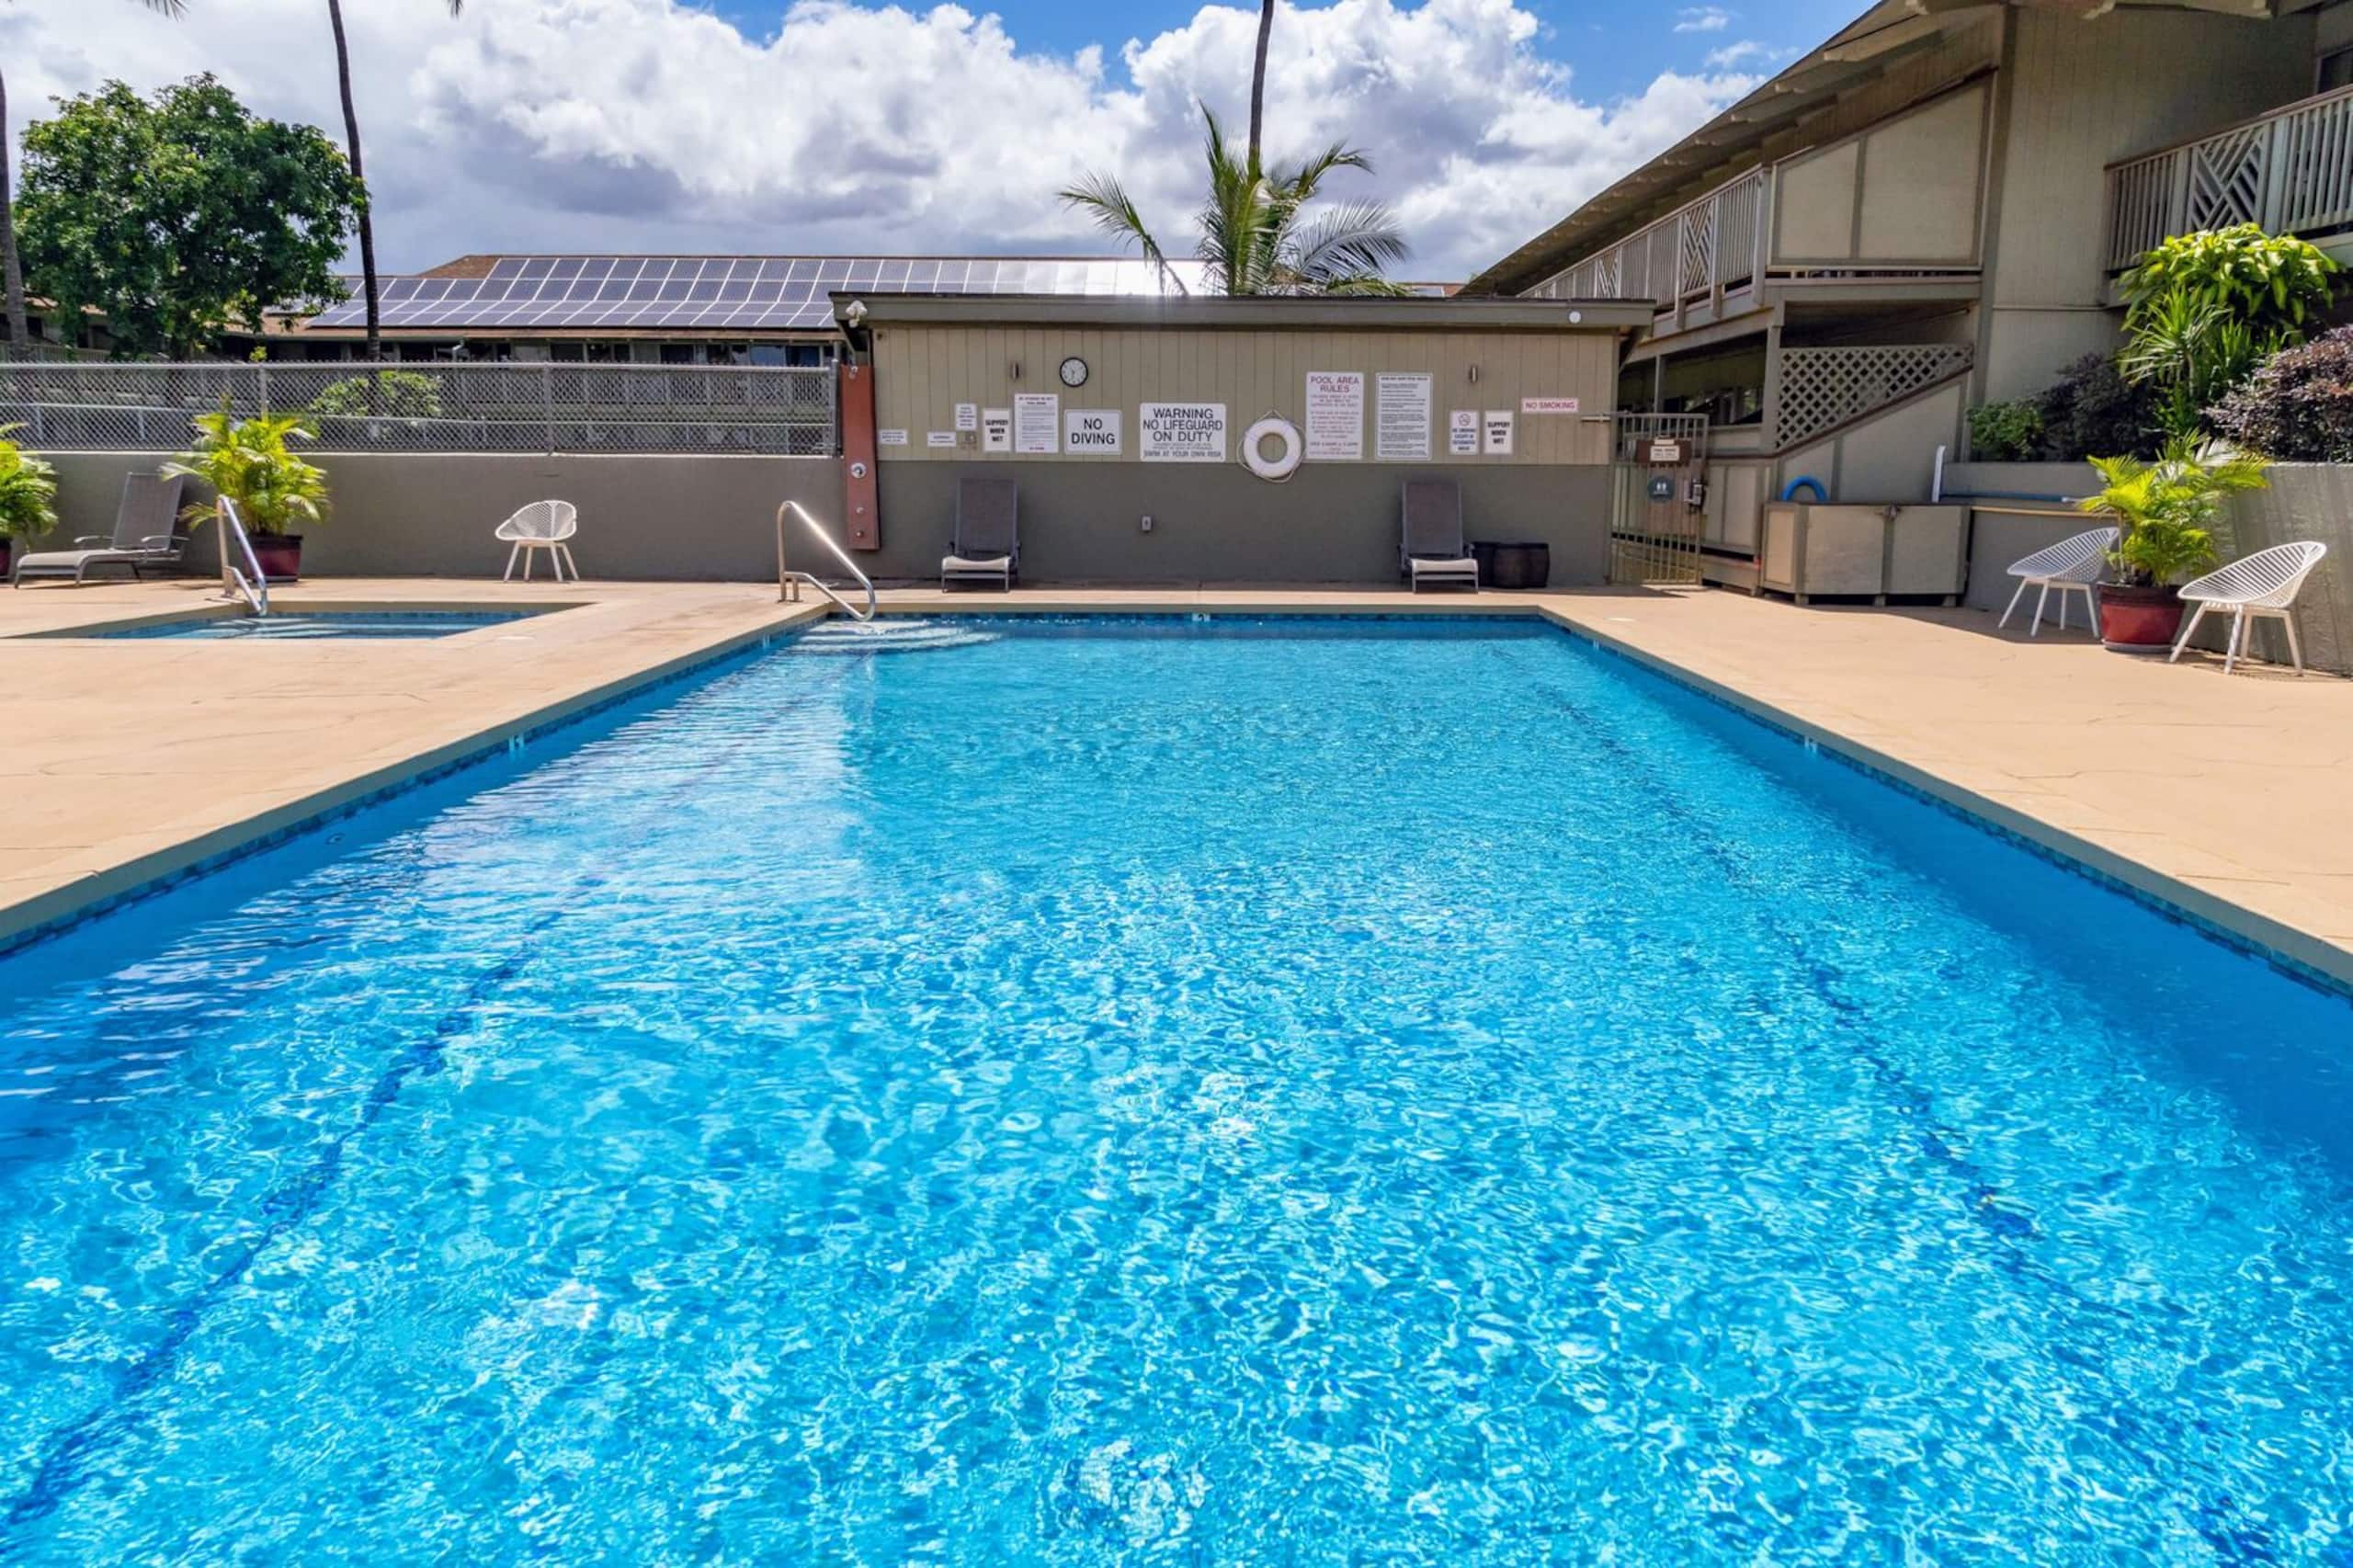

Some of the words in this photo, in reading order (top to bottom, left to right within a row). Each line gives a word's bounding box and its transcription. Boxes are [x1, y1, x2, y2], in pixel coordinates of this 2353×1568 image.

[1311, 376, 1333, 384] POOL
[1336, 376, 1359, 384] AREA
[1319, 384, 1350, 393] RULES
[1525, 401, 1538, 409] NO
[1540, 401, 1575, 409] SMOKING
[1153, 407, 1214, 419] WARNING
[1084, 418, 1103, 431] NO
[1142, 419, 1160, 430] NO
[1164, 419, 1222, 430] LIFEGUARD
[1071, 432, 1116, 446] DIVING
[1153, 431, 1173, 442] ON
[1177, 431, 1213, 442] DUTY
